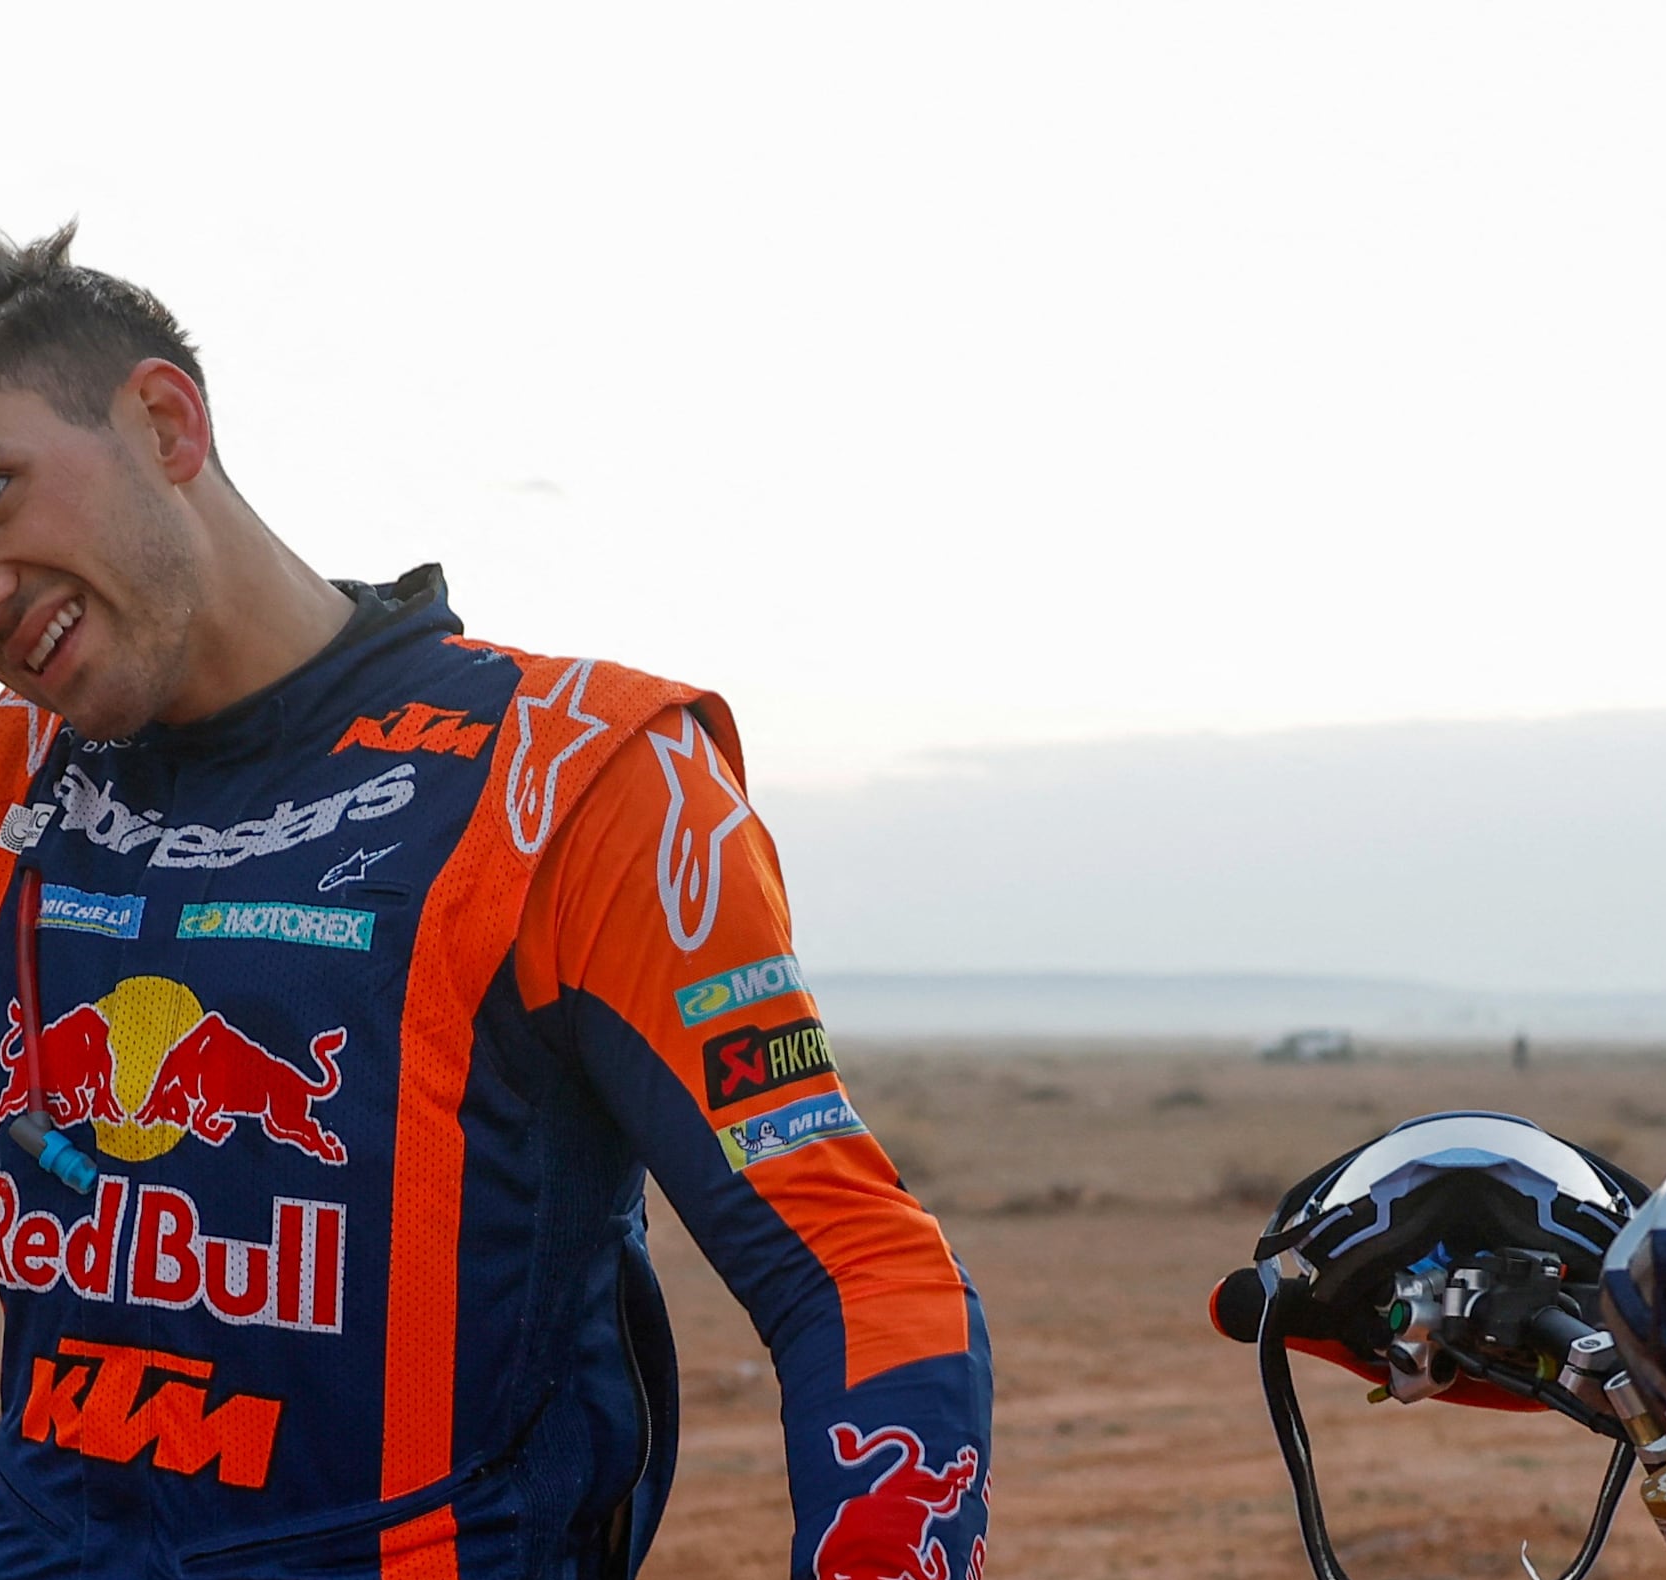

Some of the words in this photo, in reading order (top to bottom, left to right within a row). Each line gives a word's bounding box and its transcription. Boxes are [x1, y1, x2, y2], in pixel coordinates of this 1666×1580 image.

[327, 702, 497, 759] KTM
[221, 907, 365, 946] MOTOREX
[127, 1183, 347, 1334] Bull
[21, 1336, 282, 1489] KTM
